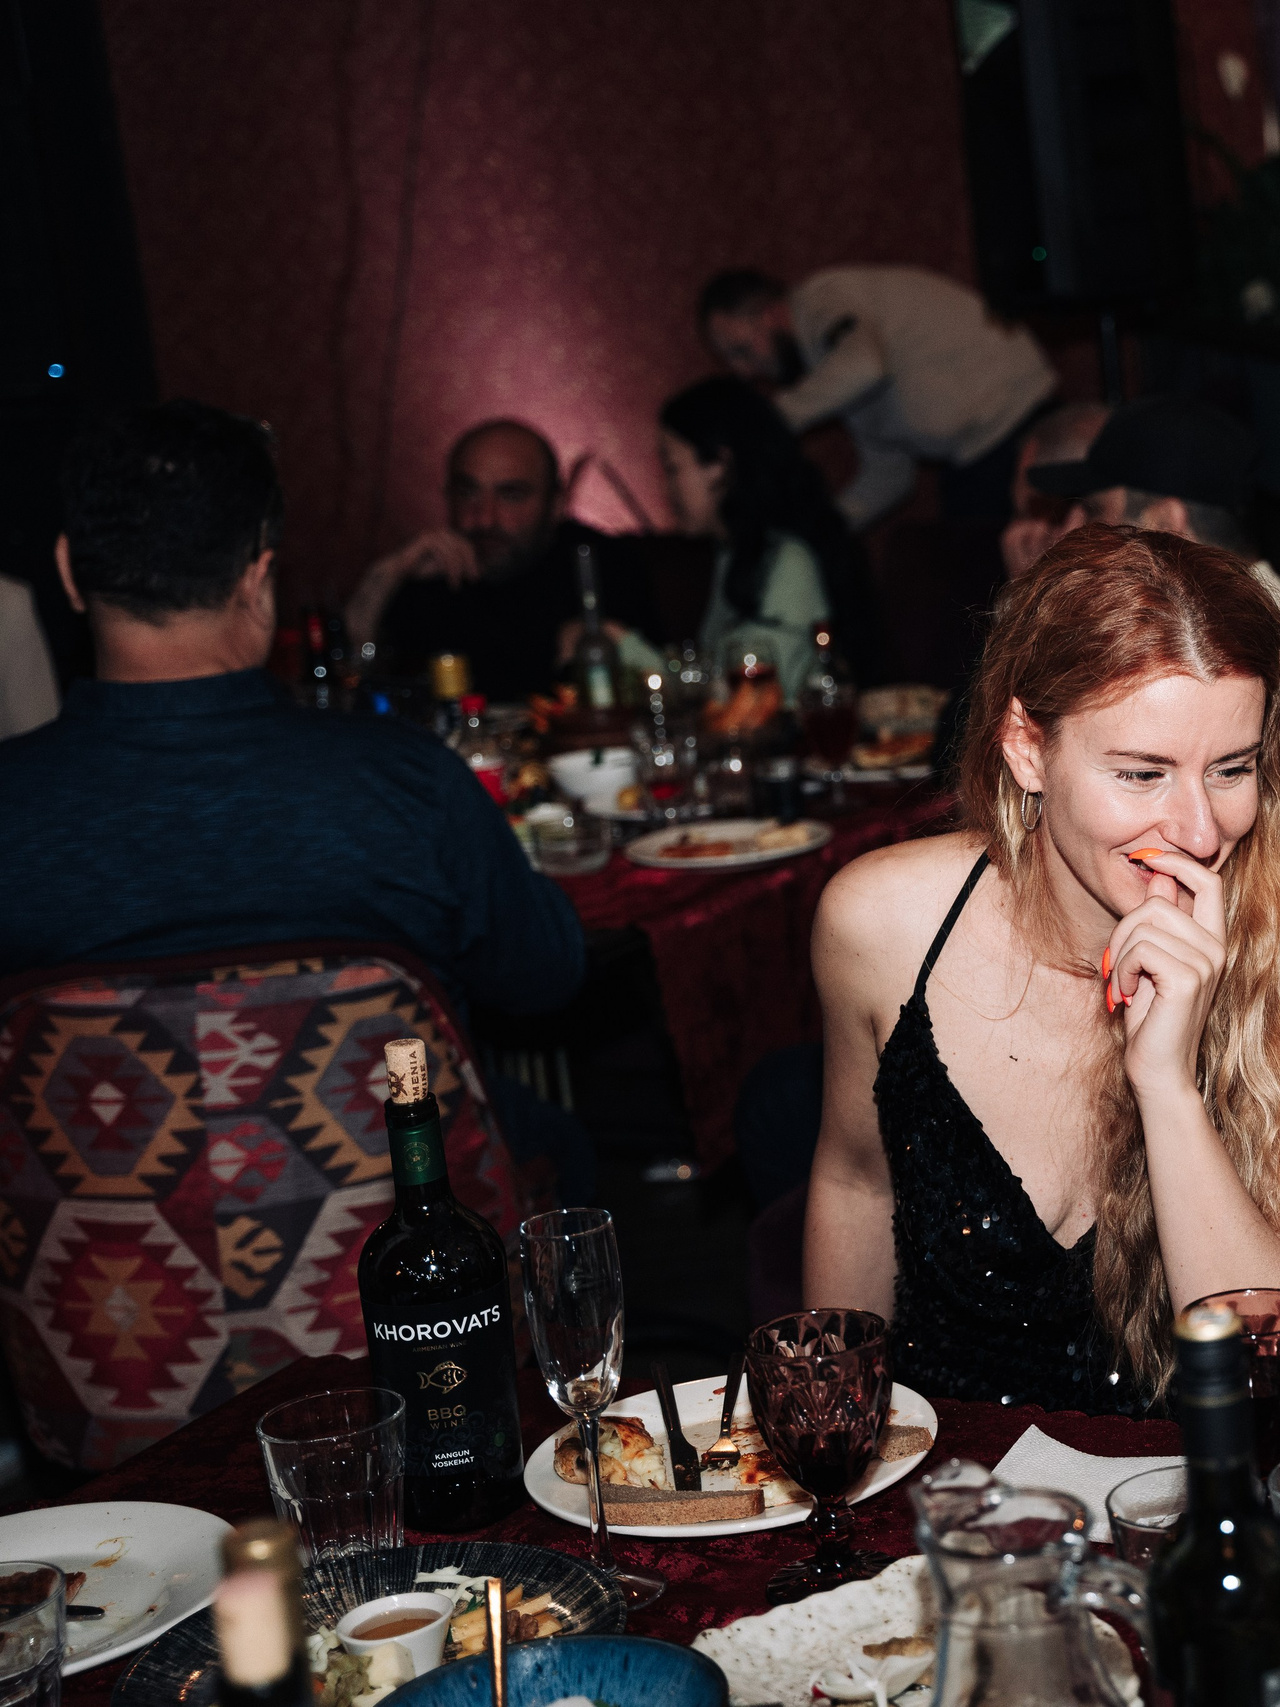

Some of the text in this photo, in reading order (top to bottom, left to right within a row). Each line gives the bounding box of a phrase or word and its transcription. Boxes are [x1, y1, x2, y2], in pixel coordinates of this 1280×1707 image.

[409, 1051, 420, 1103] RMENIA
[373, 1304, 501, 1341] KHOROVATS
[412, 1343, 448, 1353] ARMENIAN
[427, 1404, 467, 1421] BBQ
[430, 1418, 468, 1430] WINE
[434, 1449, 470, 1461] KANGUN
[431, 1456, 475, 1469] VOSKEHAT
